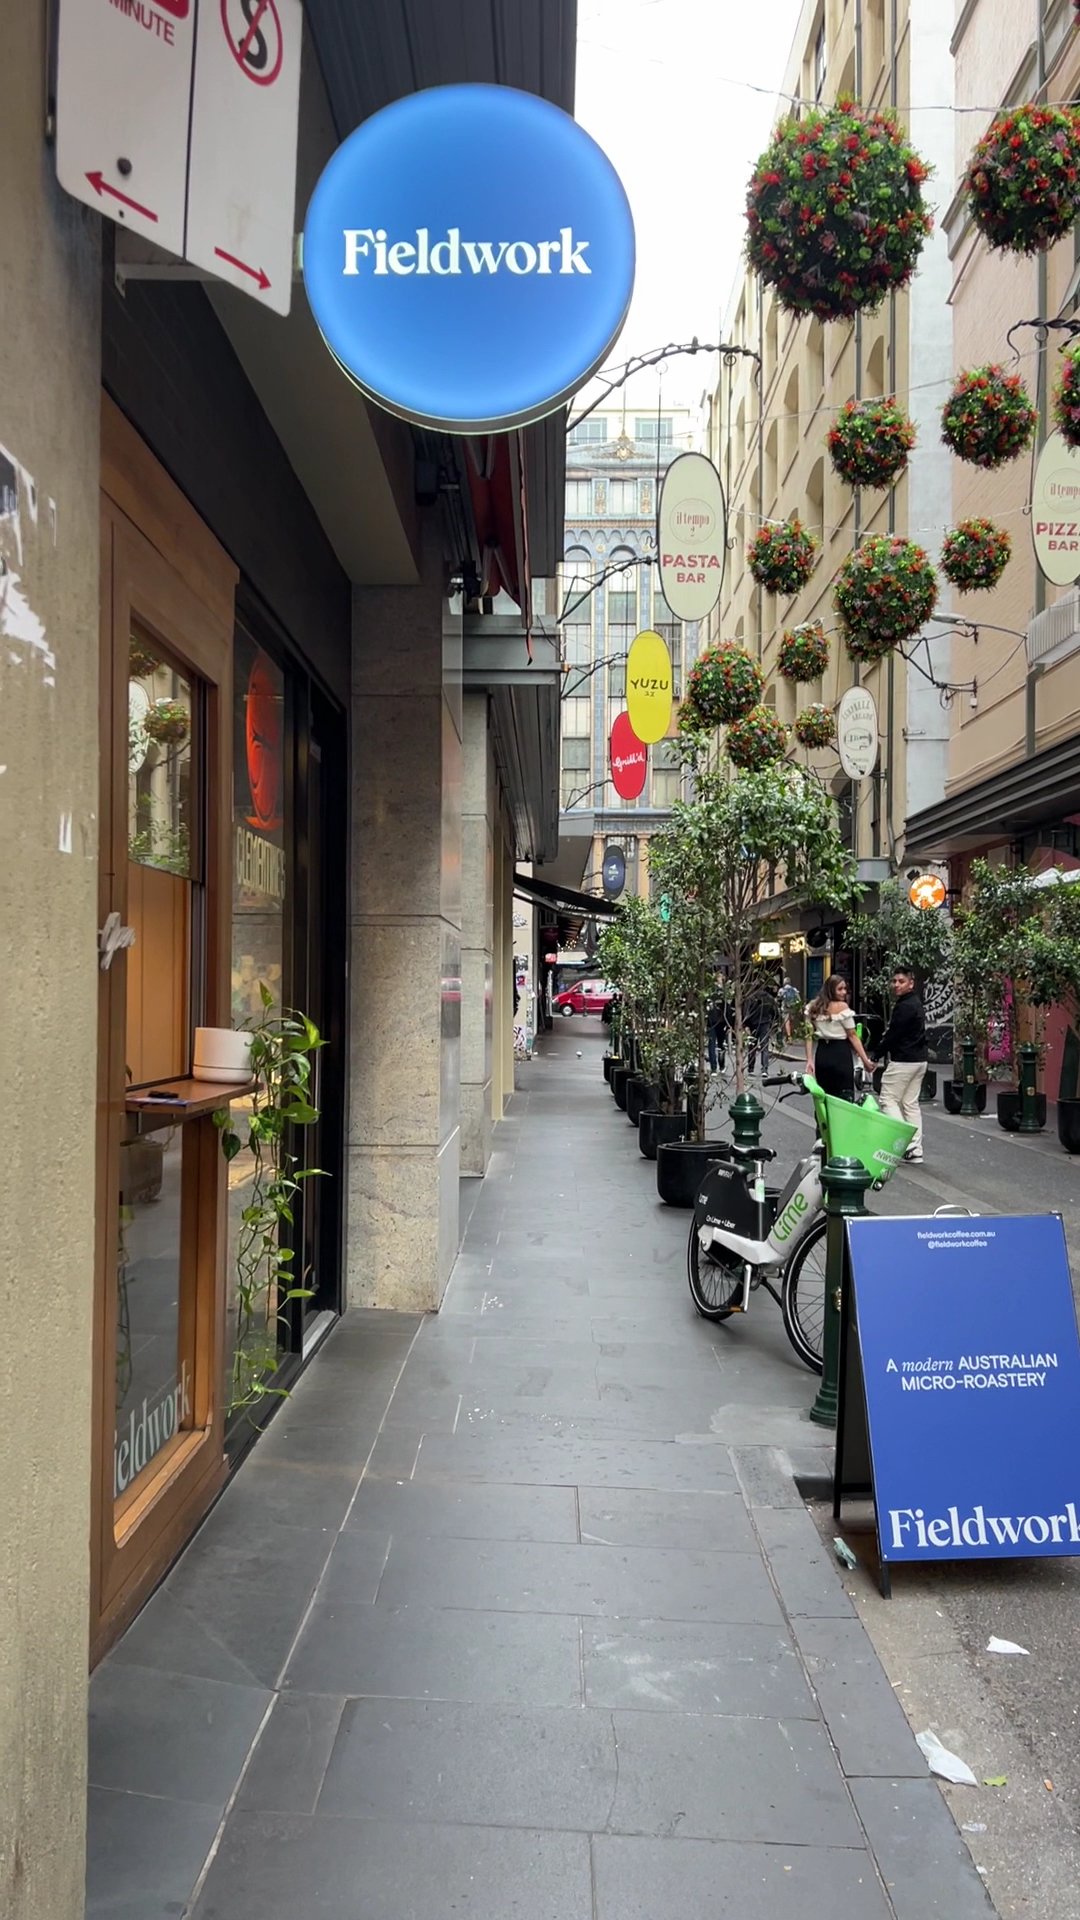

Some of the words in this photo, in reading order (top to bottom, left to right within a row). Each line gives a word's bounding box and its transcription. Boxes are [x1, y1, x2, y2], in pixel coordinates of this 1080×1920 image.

[342, 227, 592, 275] Fieldwork
[1057, 484, 1080, 499] temp
[1036, 522, 1080, 536] PIZZ
[1048, 540, 1079, 551] BAR
[662, 554, 720, 568] PASTA
[676, 572, 706, 583] BAR
[630, 678, 669, 690] YUZU
[612, 752, 645, 772] Grill'd
[773, 1193, 809, 1240] Lime
[917, 1230, 996, 1239] fieldworkcoffee.com.au
[927, 1239, 988, 1249] @fieldworkcoffee
[886, 1358, 898, 1373] A
[902, 1357, 954, 1372] modern
[958, 1353, 1058, 1370] AUSTRALIAN
[901, 1372, 1046, 1391] MICRO-ROASTERY
